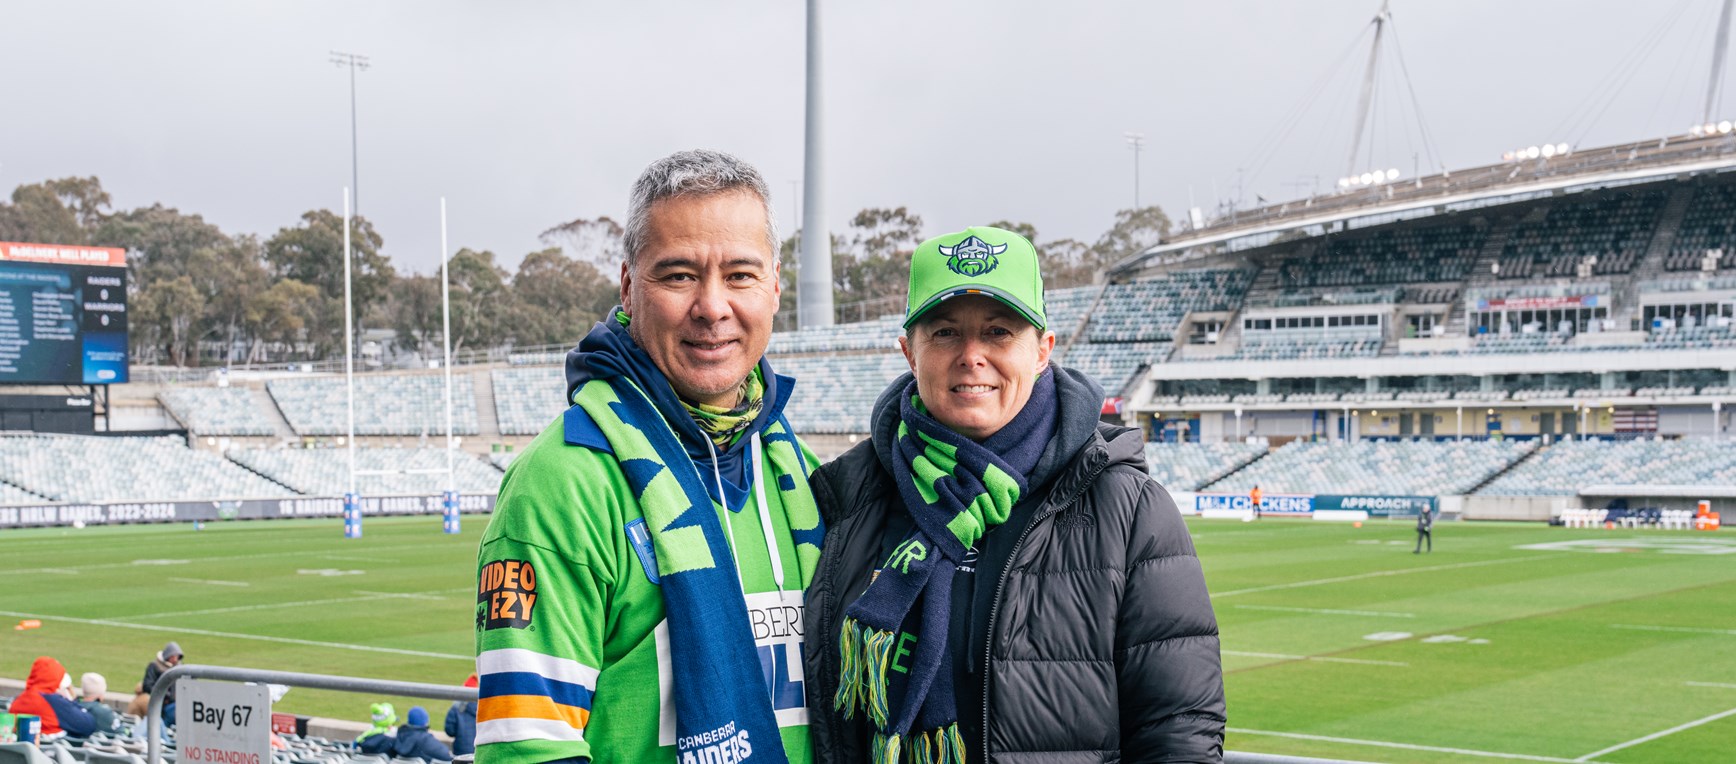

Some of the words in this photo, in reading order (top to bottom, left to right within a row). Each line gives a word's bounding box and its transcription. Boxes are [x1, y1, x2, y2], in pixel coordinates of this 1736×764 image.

[87, 276, 122, 286] RAIDERS
[101, 288, 109, 300] 0
[101, 314, 109, 326] 0
[108, 502, 175, 520] 2023-2024
[1232, 496, 1312, 512] CHCKENS
[1341, 497, 1412, 510] APPROACH
[480, 562, 536, 594] VIDEO
[491, 590, 536, 621] EZY
[748, 605, 805, 640] BER
[193, 701, 226, 730] Bay
[232, 705, 252, 727] 67
[678, 720, 736, 750] CANBERRA
[185, 746, 201, 760] NO
[205, 748, 259, 764] STANDING
[677, 729, 752, 764] AIDERS
